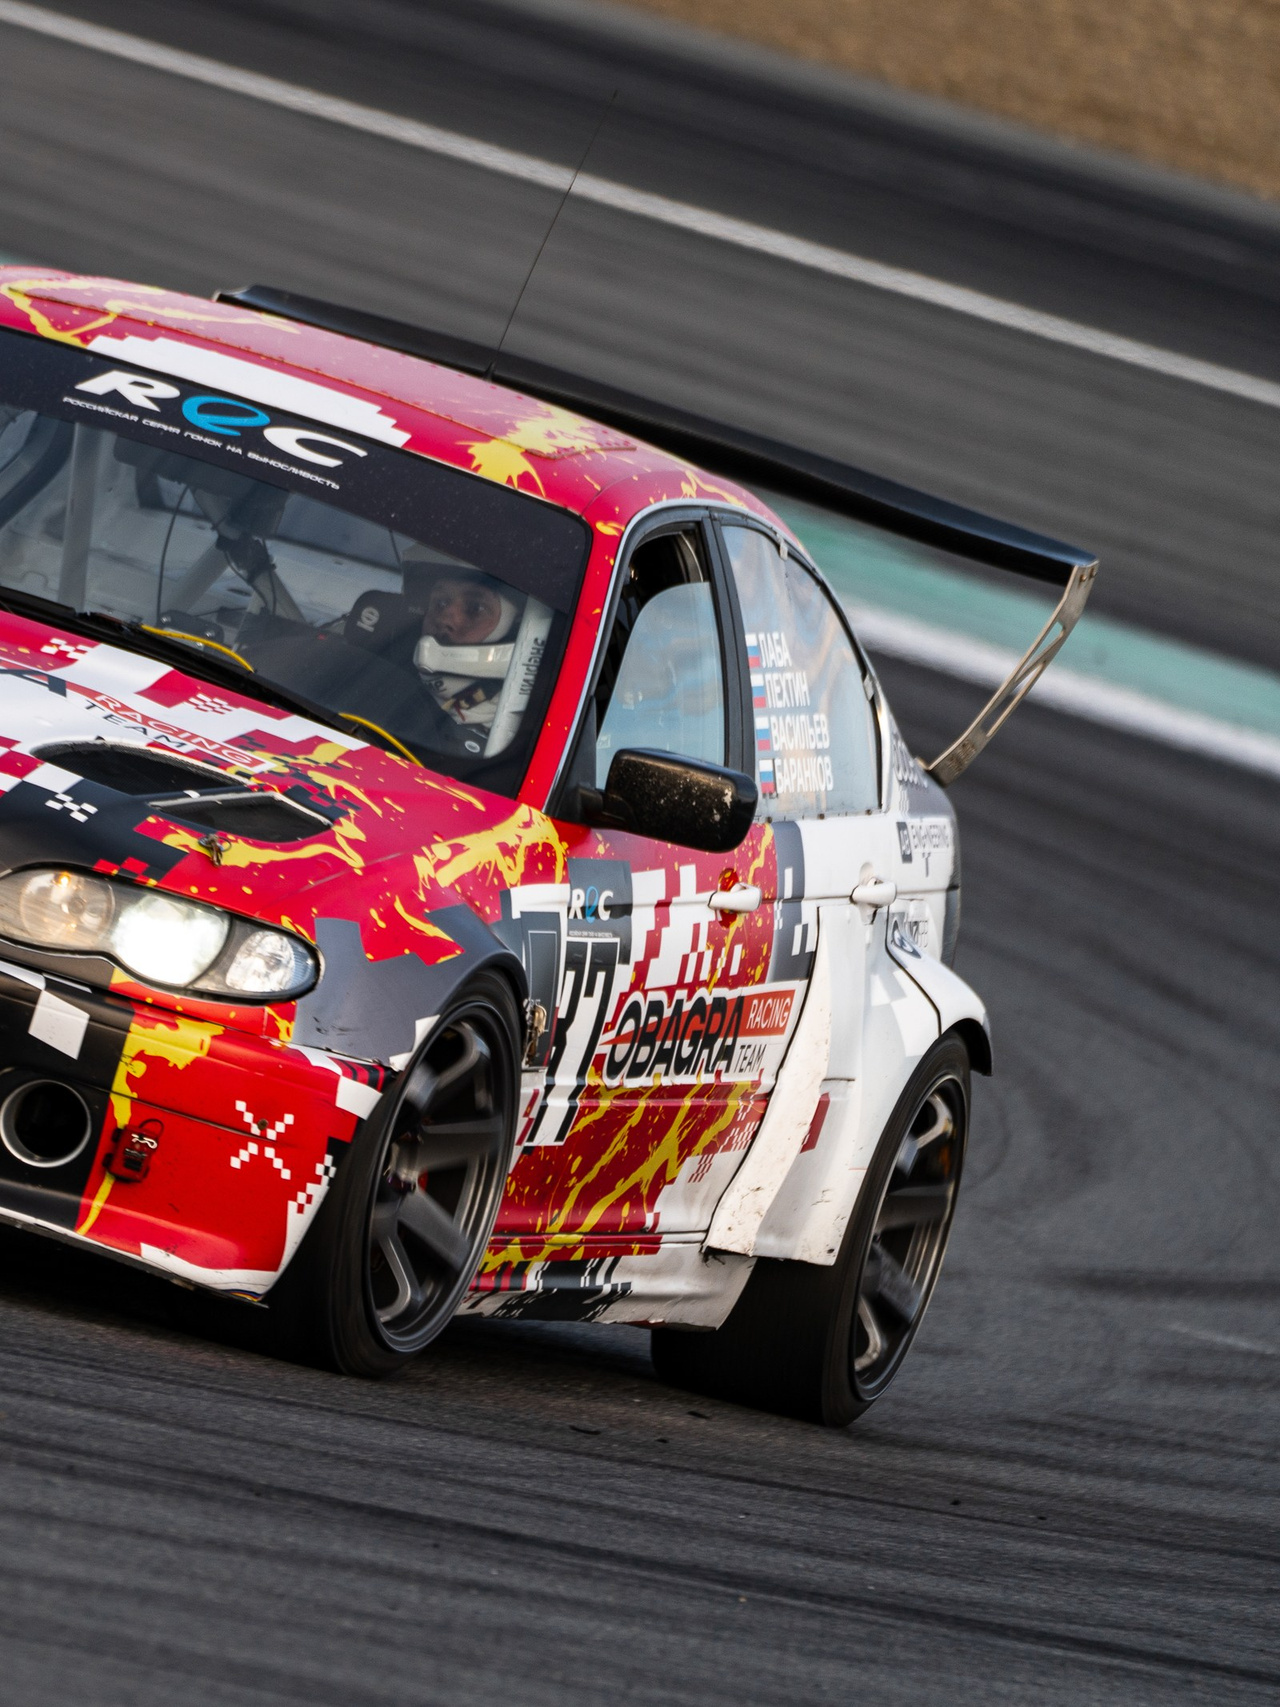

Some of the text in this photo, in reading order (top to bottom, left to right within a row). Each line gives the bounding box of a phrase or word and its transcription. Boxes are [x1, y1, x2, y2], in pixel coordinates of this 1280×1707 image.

[62, 396, 340, 490] РОССИЙСКАЯ СЕРИЯ ГОНОК НА ВЫНОСЛИВОСТЬ
[758, 631, 792, 668] ЛАБА
[764, 671, 810, 708] ПЕХТИН
[85, 699, 188, 750] TEAM
[94, 694, 253, 765] RACING
[770, 713, 830, 751] ВАСИЛЬЕВ
[775, 755, 834, 793] БАРАНКОВ
[606, 995, 791, 1080] OBAGRA RACING
[733, 1043, 766, 1074] TEAM
